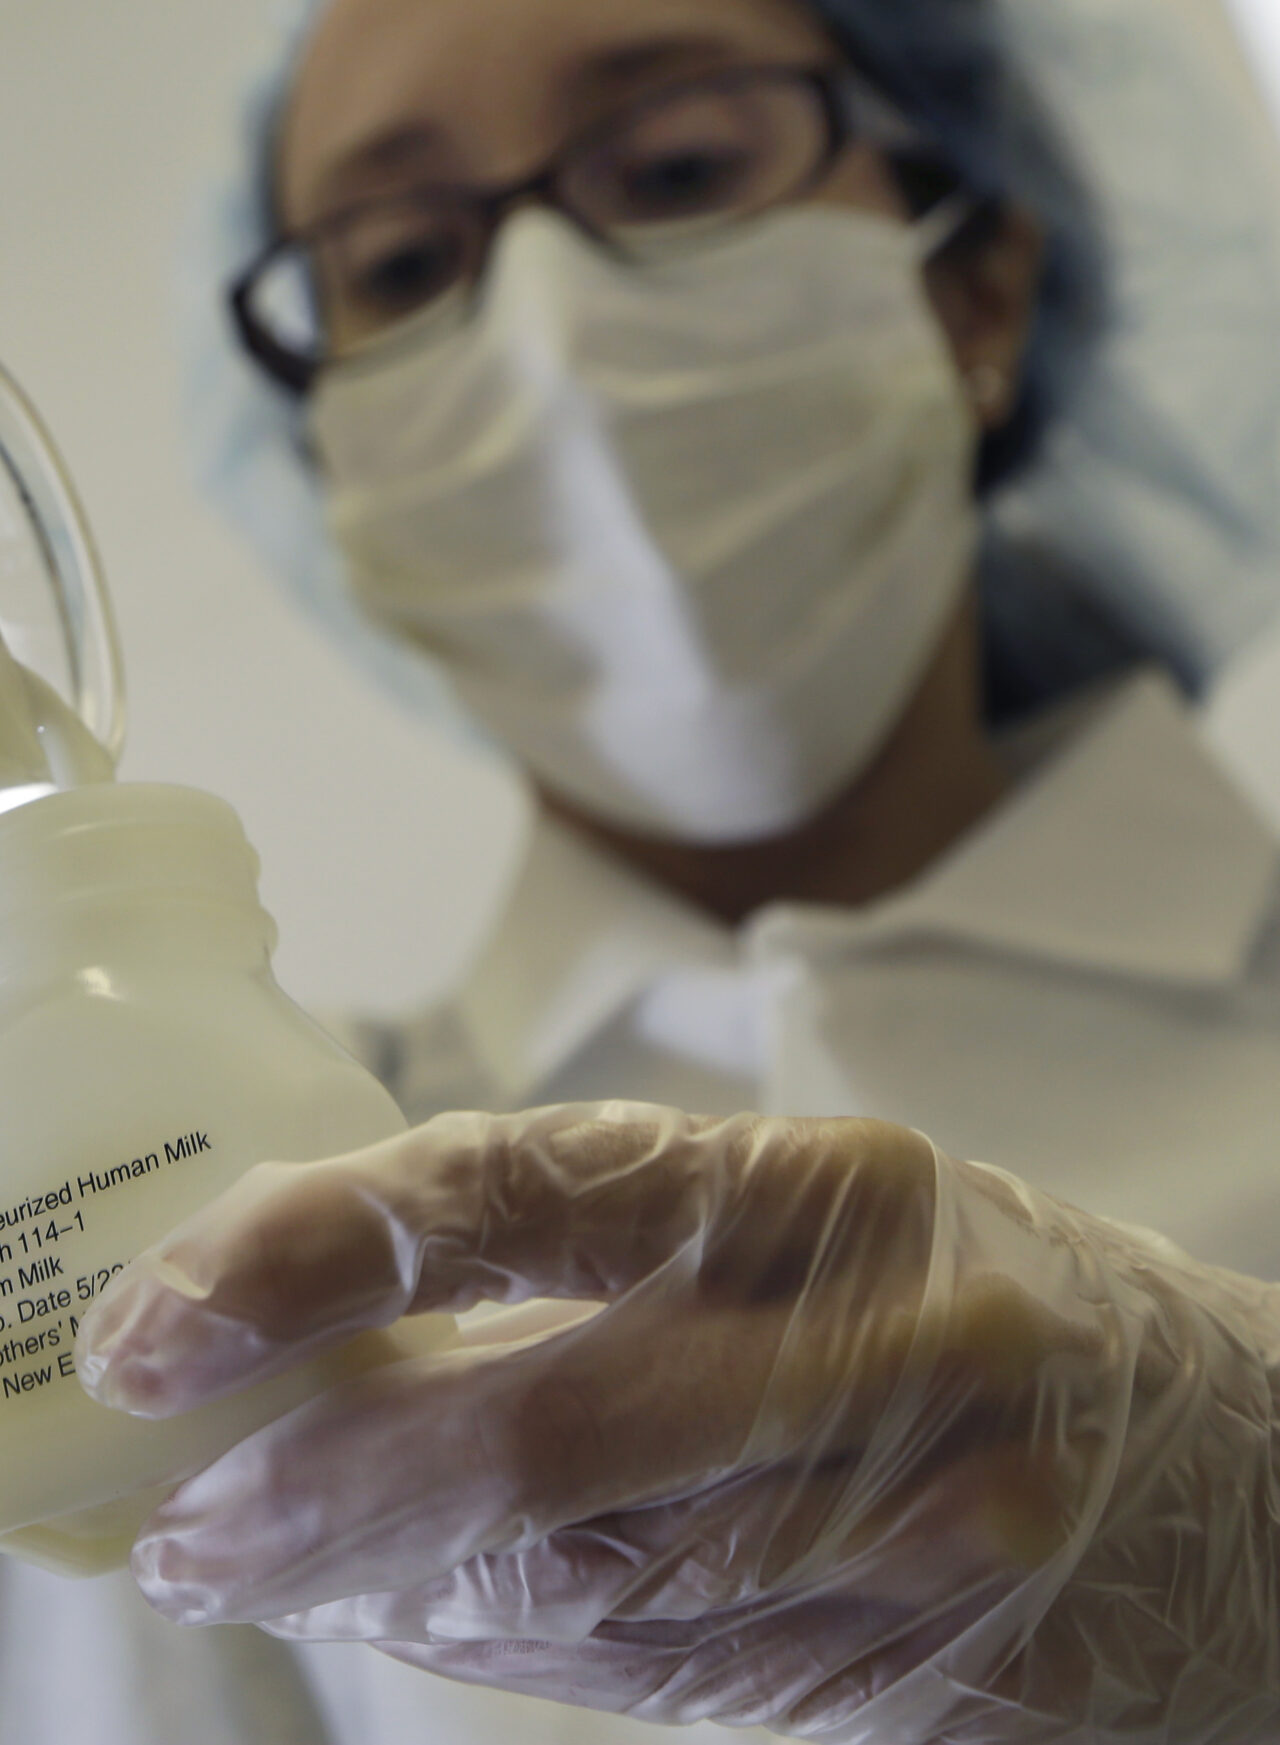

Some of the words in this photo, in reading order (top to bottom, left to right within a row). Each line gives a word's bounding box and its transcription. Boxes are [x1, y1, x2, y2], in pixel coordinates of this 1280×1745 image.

[77, 1153, 159, 1197] Human
[163, 1131, 211, 1164] Milk
[17, 1256, 64, 1293] Milk
[17, 1289, 71, 1322] Date
[4, 1363, 52, 1398] New
